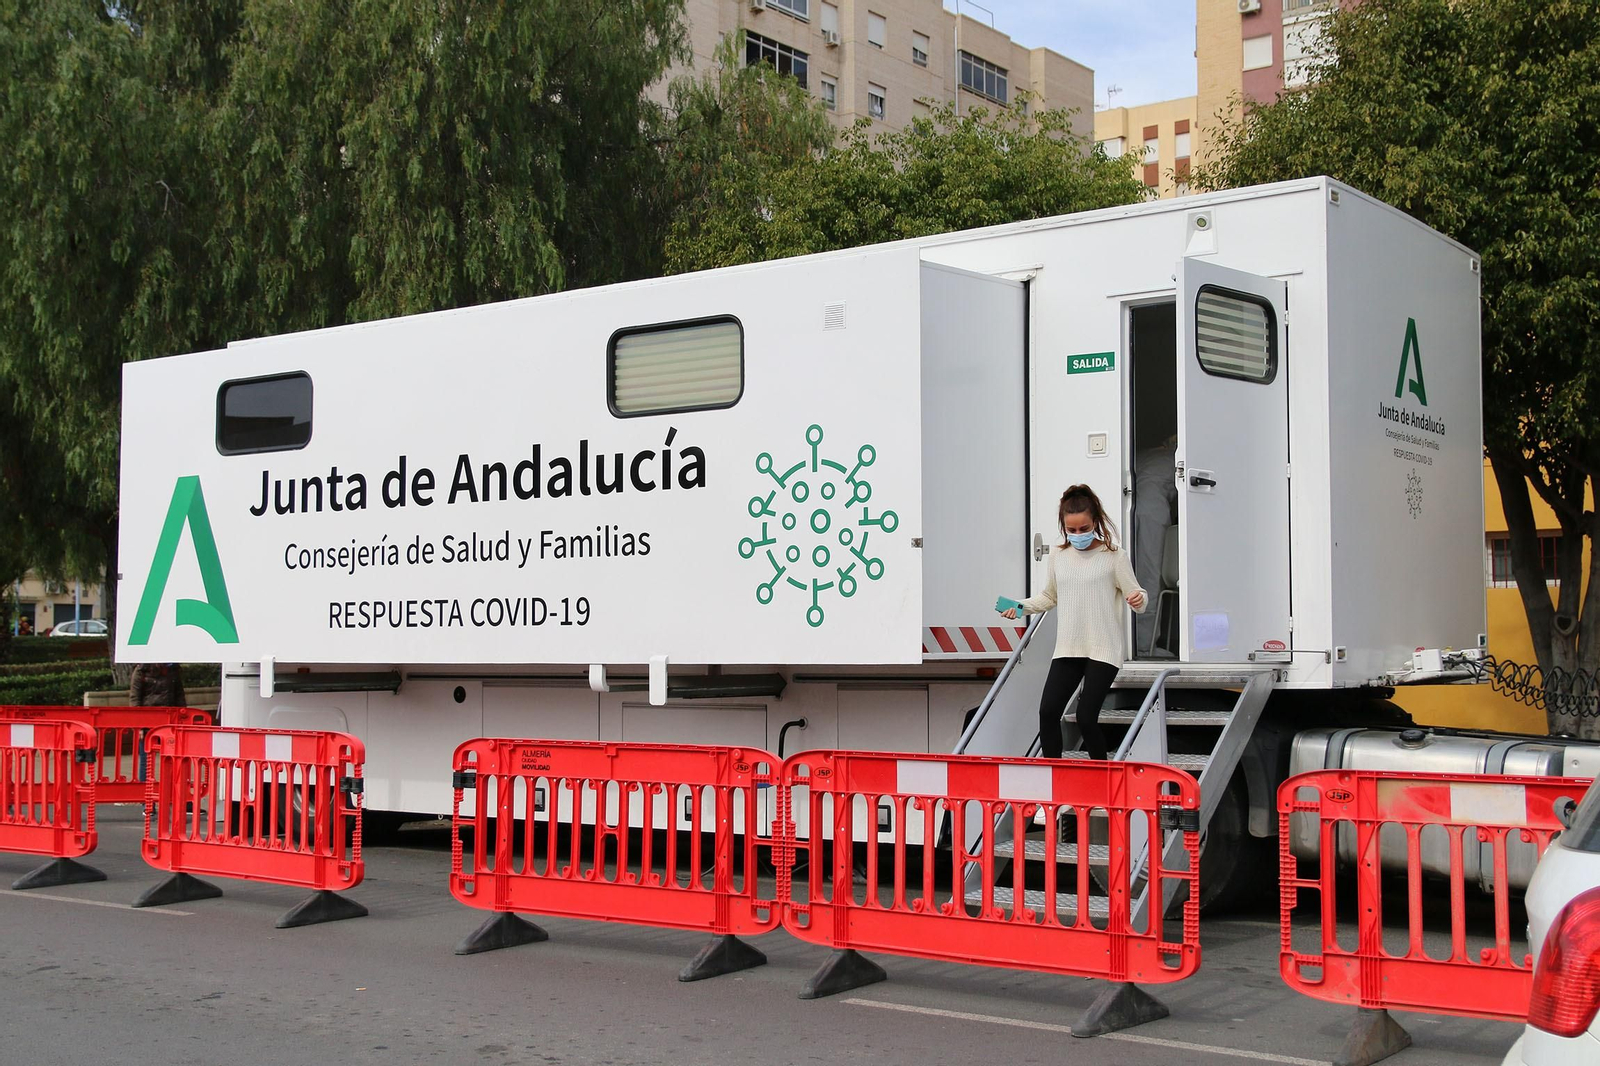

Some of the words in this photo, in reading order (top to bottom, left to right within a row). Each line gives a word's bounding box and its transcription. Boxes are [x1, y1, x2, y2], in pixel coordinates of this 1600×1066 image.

[1072, 357, 1109, 369] SALIDA
[1378, 401, 1399, 422] Junta
[1400, 407, 1410, 425] de
[1410, 411, 1445, 436] Andalucía
[249, 470, 367, 517] Junta
[382, 455, 436, 507] de
[447, 426, 706, 504] Andalucía
[284, 534, 399, 575] Consejería
[406, 535, 435, 565] de
[441, 530, 510, 564] Salud
[517, 538, 533, 569] y
[540, 525, 651, 559] Familias
[329, 599, 464, 629] RESPUESTA
[470, 596, 591, 627] COVID-19
[522, 749, 551, 758] ALMERÍA
[736, 764, 749, 772] JSP
[1330, 791, 1350, 800] JSP
